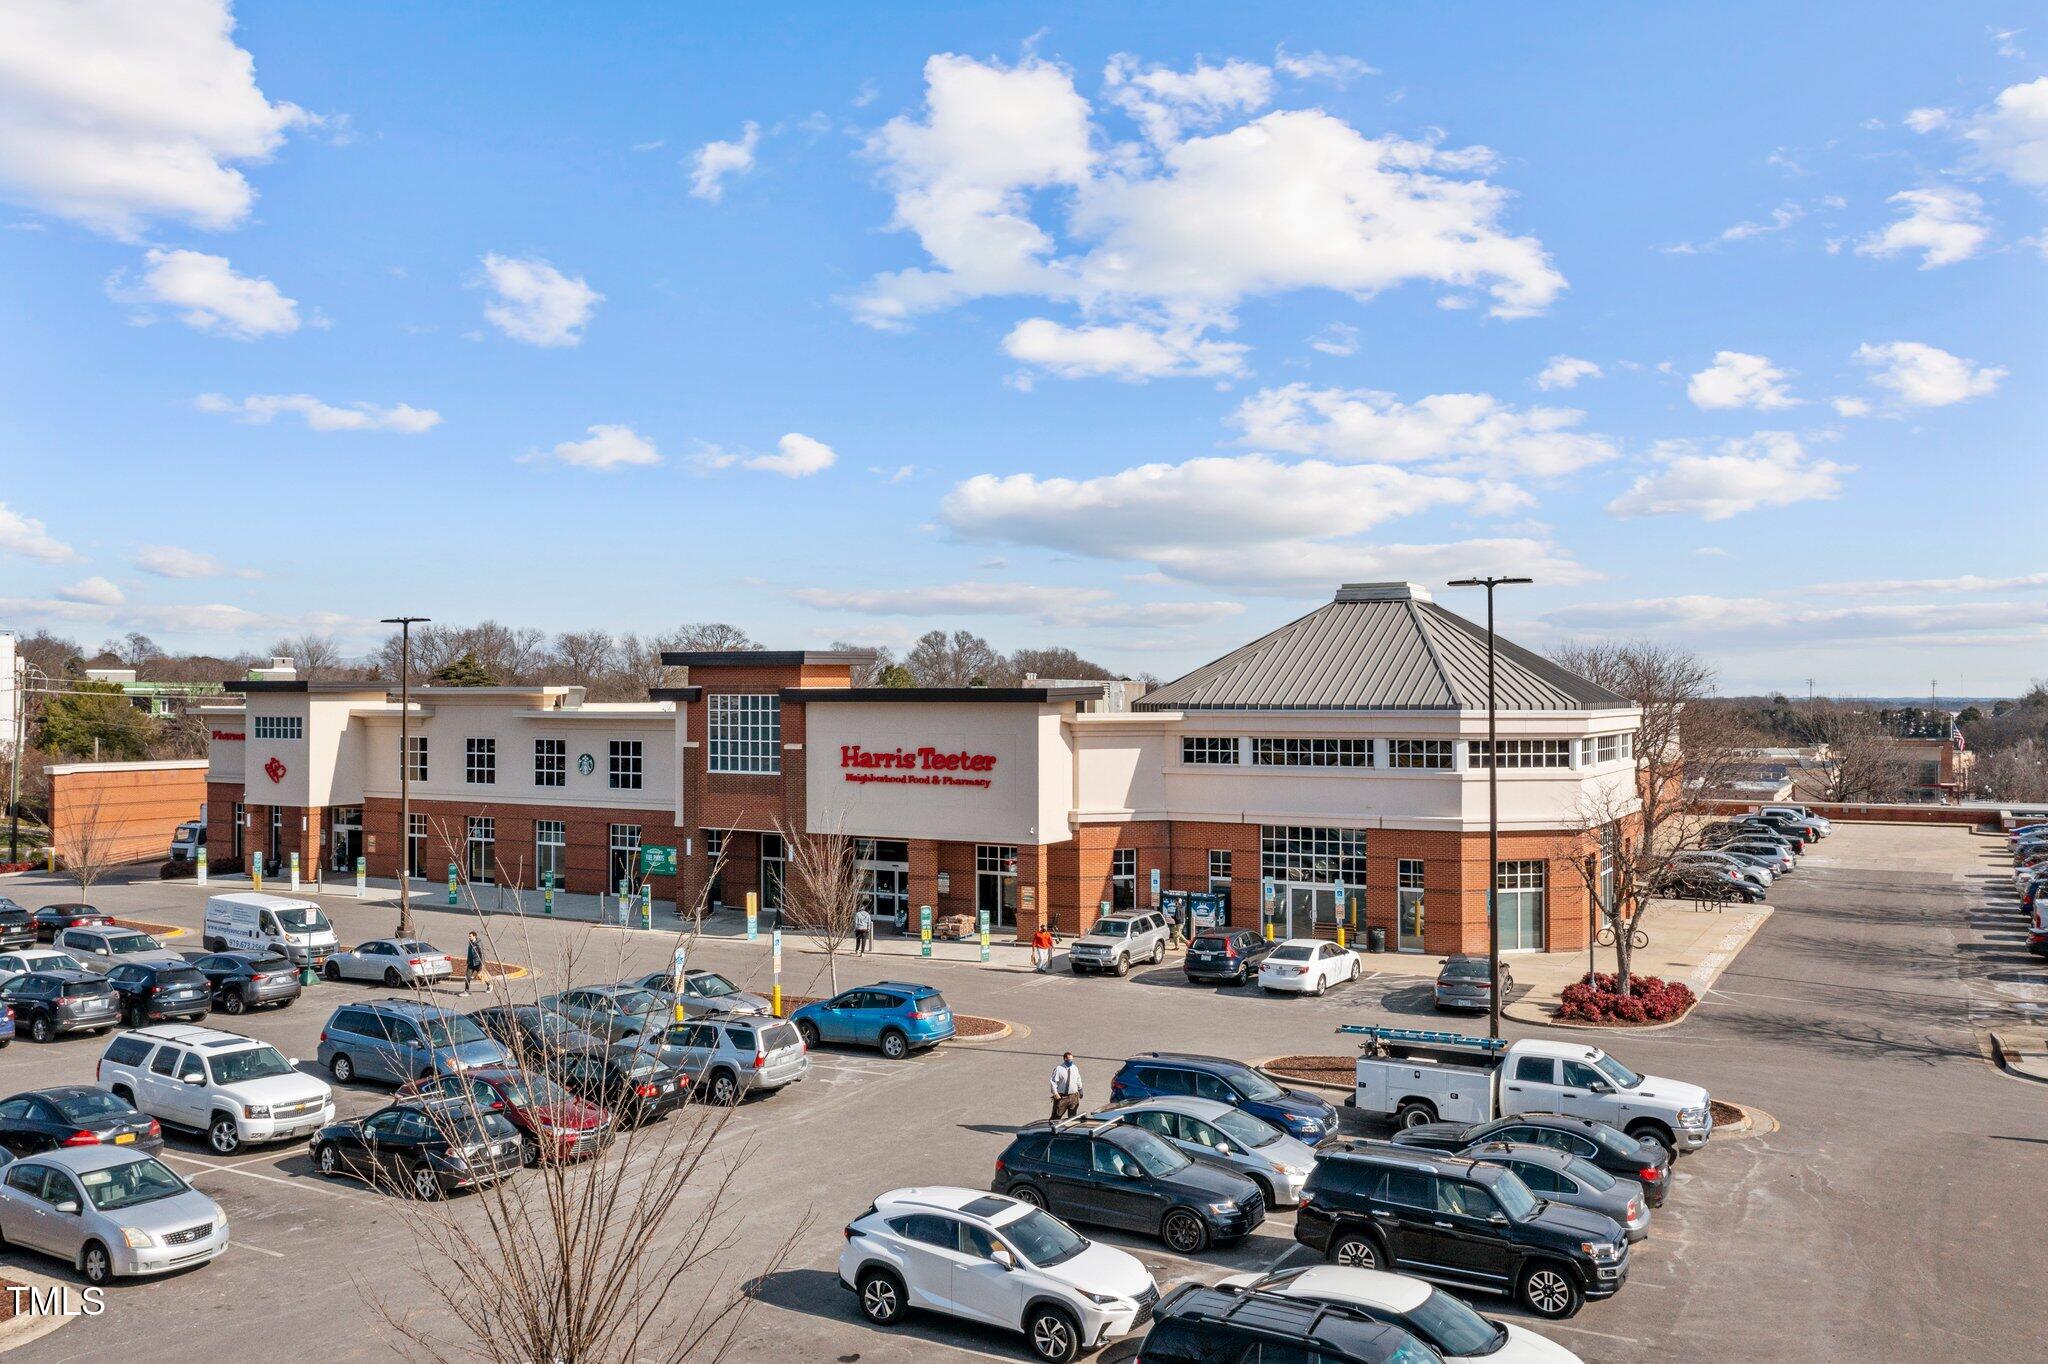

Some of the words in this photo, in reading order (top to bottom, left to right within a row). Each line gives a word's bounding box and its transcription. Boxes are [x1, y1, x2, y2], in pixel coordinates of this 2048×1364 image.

[840, 745, 917, 769] Harris
[917, 747, 997, 771] Teeter
[845, 773, 907, 784] Neighborhood
[908, 775, 930, 785] Food
[931, 775, 942, 785] &
[942, 776, 991, 788] Pharmacy
